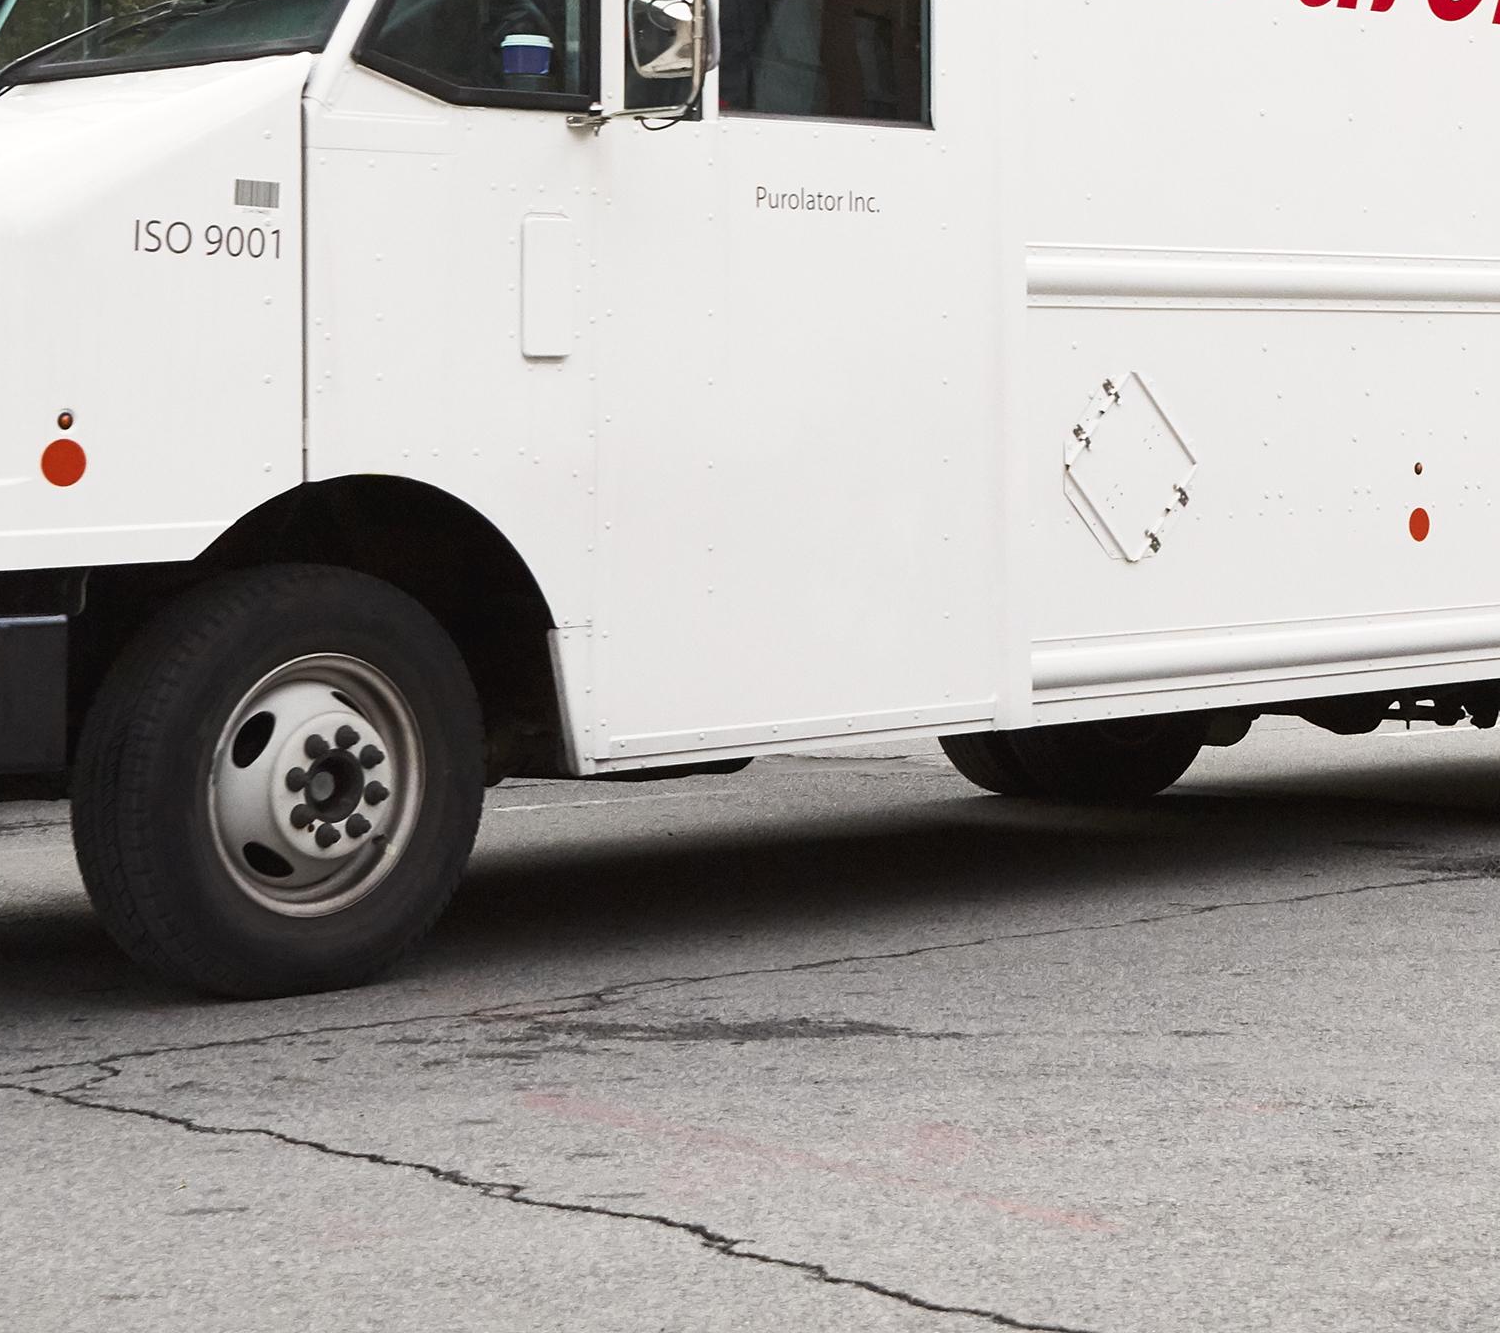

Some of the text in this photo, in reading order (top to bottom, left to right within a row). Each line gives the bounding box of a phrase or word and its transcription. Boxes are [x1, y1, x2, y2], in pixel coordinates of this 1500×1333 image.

[756, 186, 880, 213] Purolator Inc.
[134, 219, 281, 259] ISO 9001
